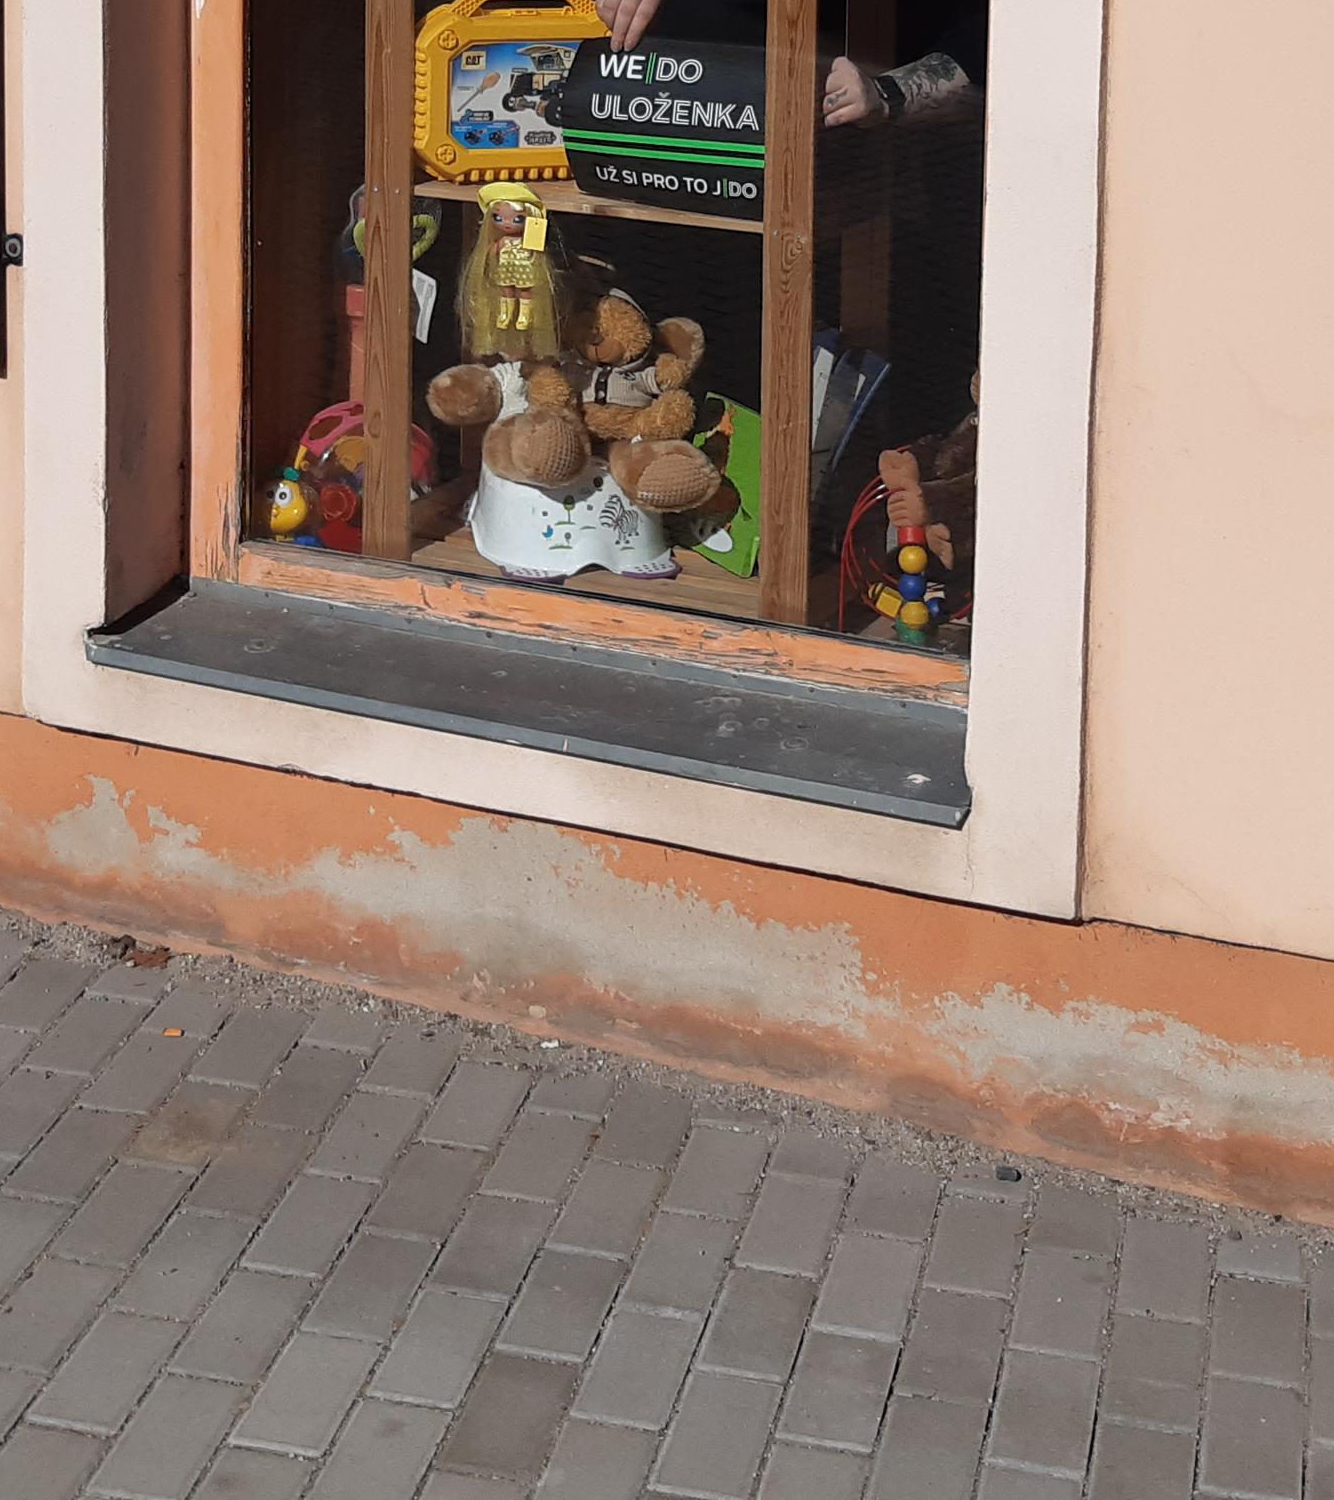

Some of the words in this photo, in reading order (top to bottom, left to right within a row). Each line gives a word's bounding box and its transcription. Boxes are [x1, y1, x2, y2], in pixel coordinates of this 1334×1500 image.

[465, 55, 484, 66] CAT
[591, 92, 760, 131] ULOŽENKA
[596, 165, 619, 182] UŽ
[622, 170, 638, 185] SI
[642, 173, 679, 190] PRO
[683, 177, 708, 194] TO
